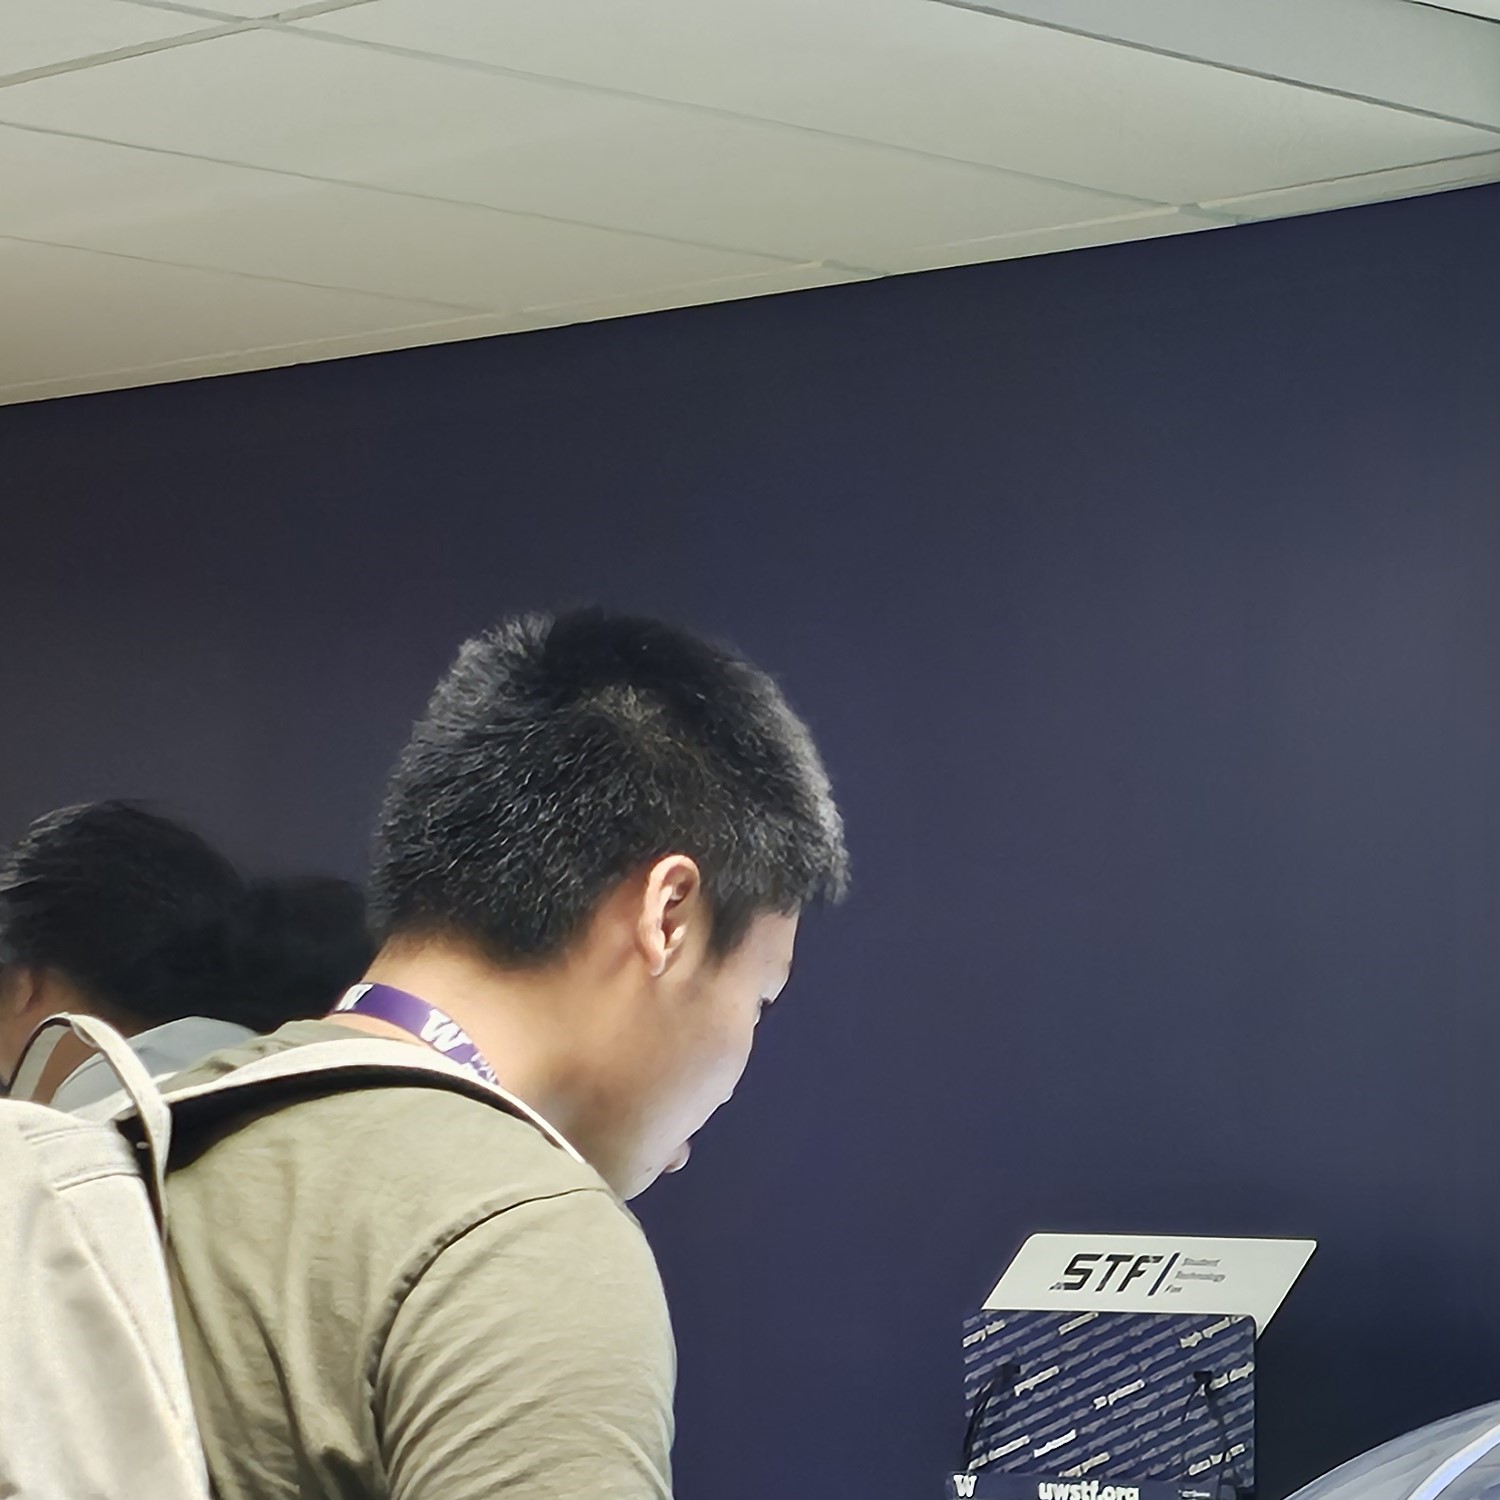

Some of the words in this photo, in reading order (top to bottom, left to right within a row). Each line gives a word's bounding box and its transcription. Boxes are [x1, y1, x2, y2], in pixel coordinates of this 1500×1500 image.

[420, 1009, 473, 1053] W
[1049, 1253, 1164, 1292] STF
[953, 1474, 977, 1498] W
